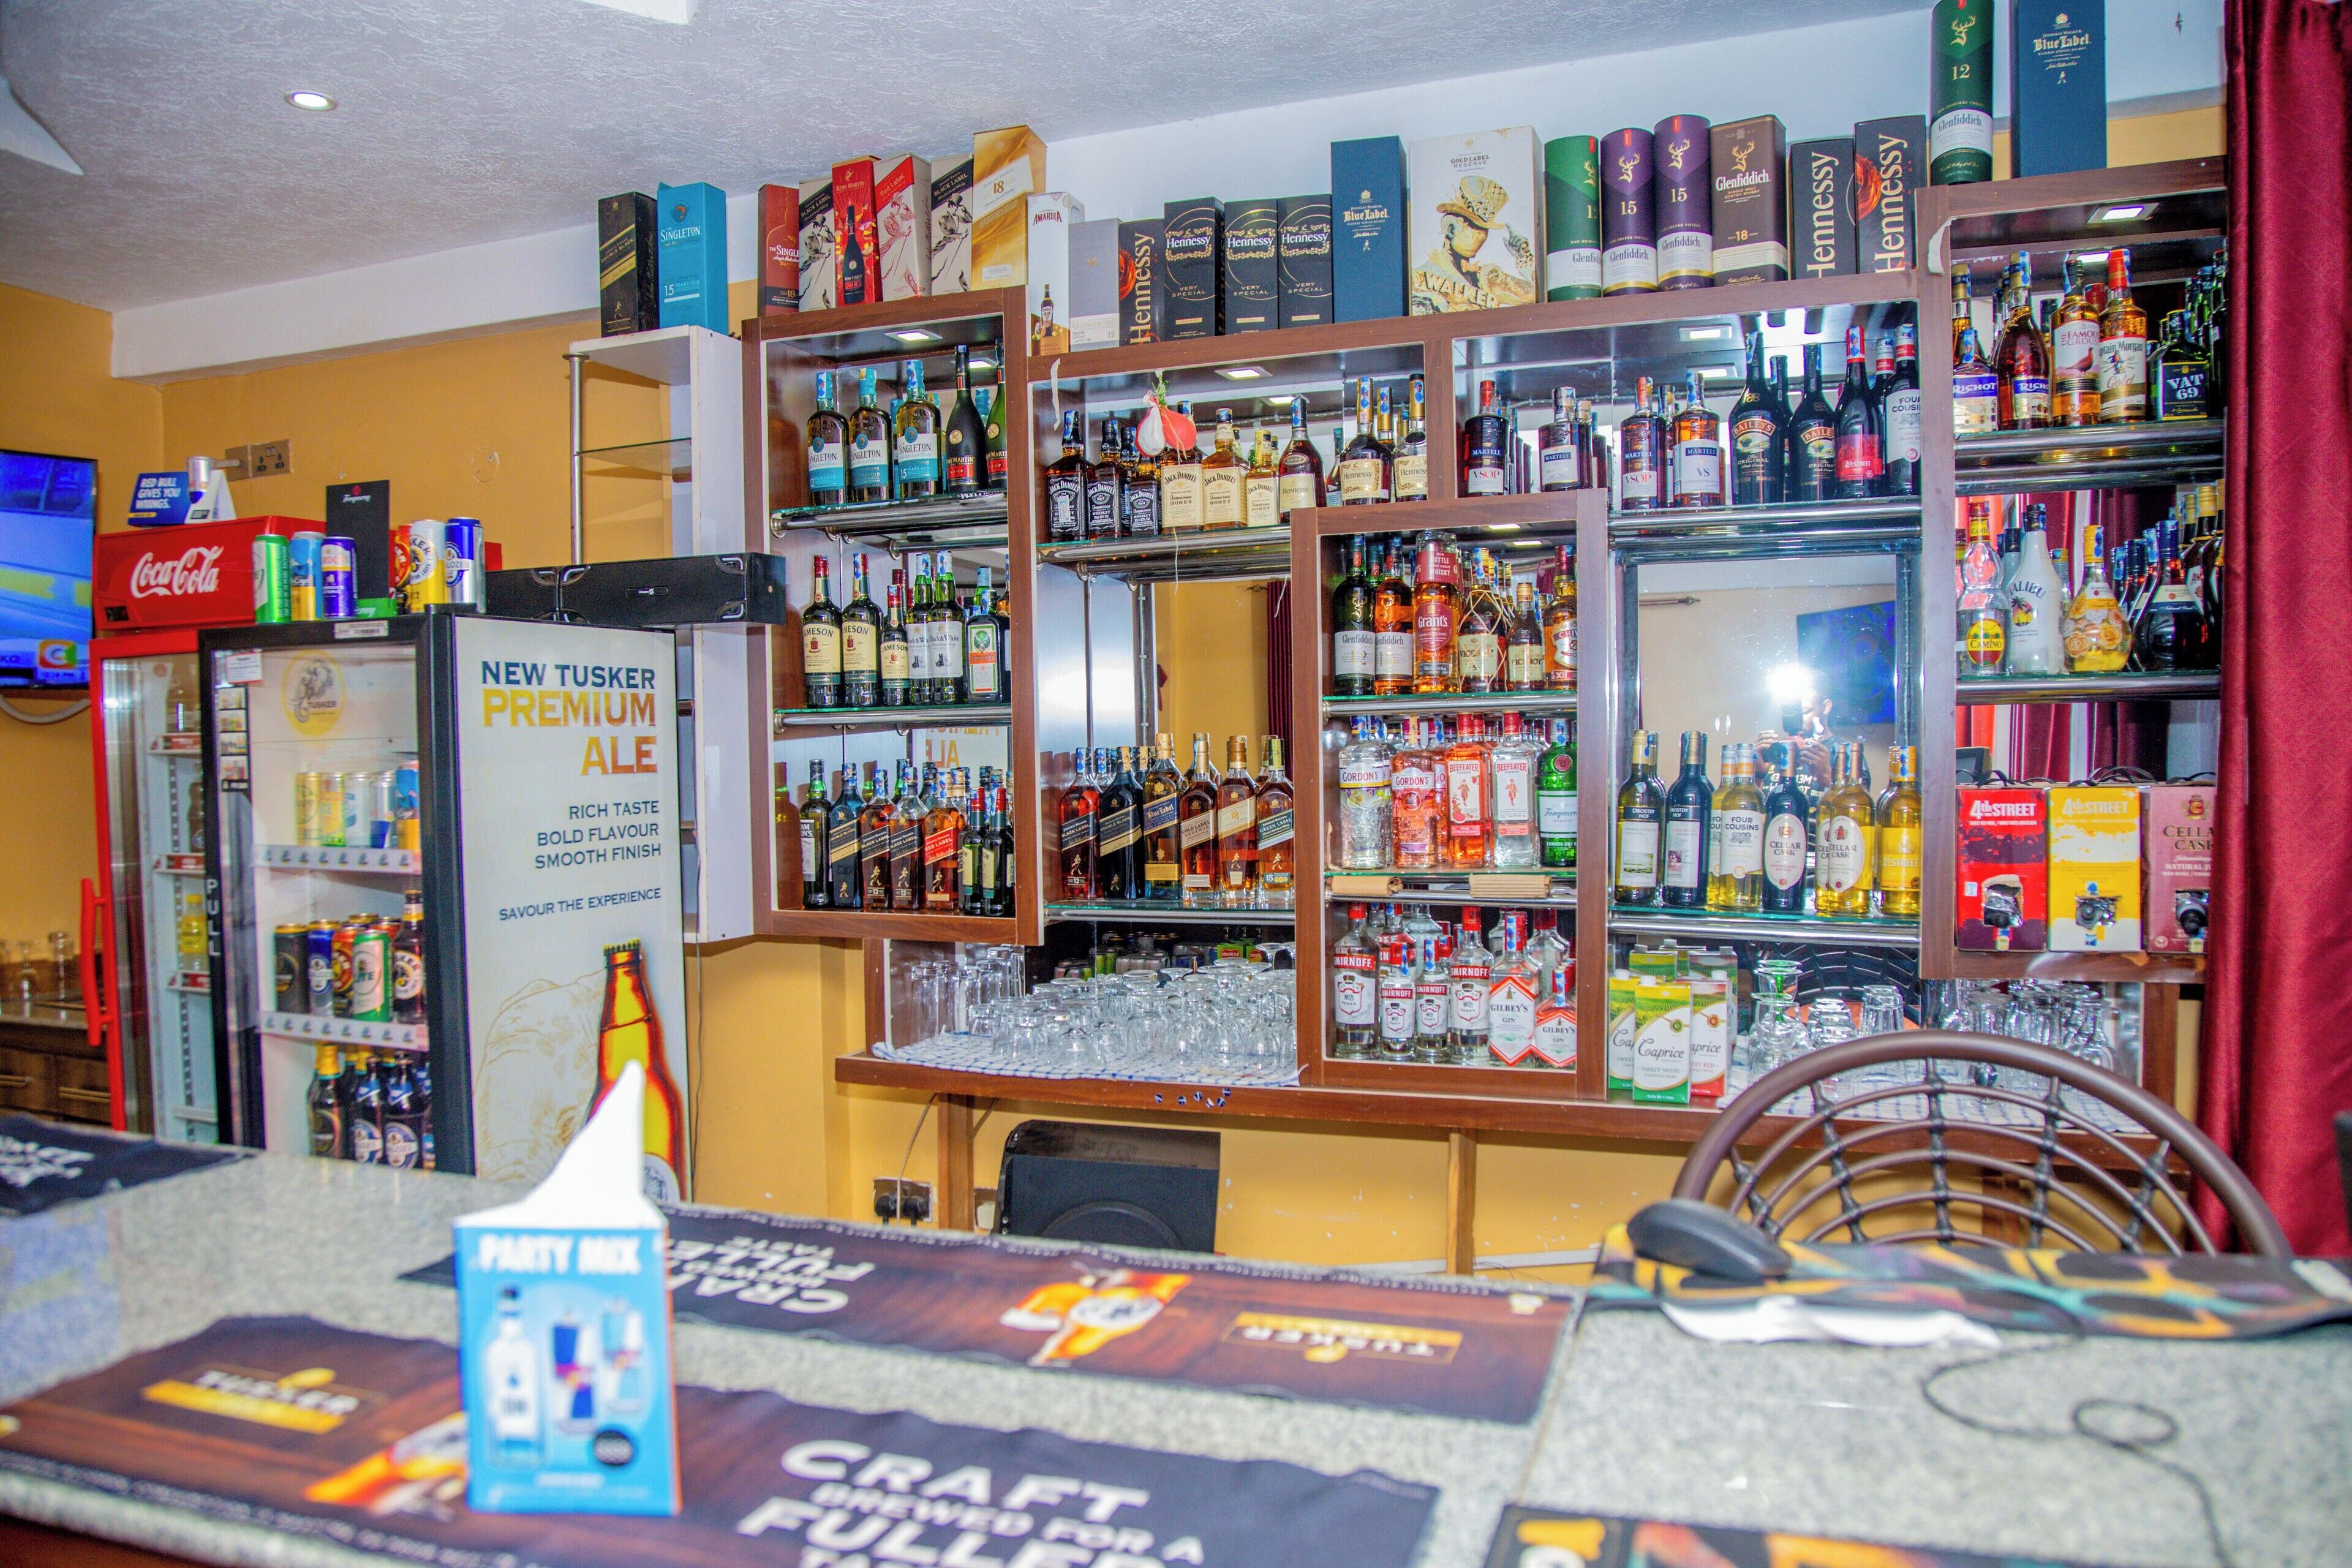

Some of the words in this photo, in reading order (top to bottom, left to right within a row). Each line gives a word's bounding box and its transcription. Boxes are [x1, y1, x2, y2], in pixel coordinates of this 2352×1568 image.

[2034, 39, 2059, 52] Blue
[2060, 34, 2091, 48] Label
[1953, 64, 1970, 80] 12
[1939, 114, 1982, 132] Glenfiddich
[880, 185, 891, 196] Red
[891, 173, 905, 187] Label
[934, 184, 951, 195] BLACK
[952, 173, 968, 184] LABEL
[1716, 169, 1770, 191] Glenfiddich
[993, 181, 1004, 194] 18
[1670, 187, 1687, 203] 15
[801, 204, 815, 217] BLACK
[816, 195, 831, 206] LABEL
[1621, 201, 1637, 215] 15
[1875, 134, 1907, 273] Hennessy
[1033, 211, 1062, 225] AMARULA
[1344, 210, 1364, 222] Blue
[1365, 208, 1388, 219] Label
[660, 226, 700, 242] SINGLETON
[1281, 232, 1328, 244] Hennessy
[1736, 230, 1747, 241] 18
[619, 238, 634, 251] BLACK
[1166, 235, 1211, 249] Hennessy
[1227, 237, 1273, 248] Hennessy
[1662, 235, 1700, 251] Glenfiddich
[1610, 249, 1648, 263] Glenfiddich
[664, 284, 674, 296] 15
[1130, 233, 1155, 344] Hennessy
[2119, 341, 2143, 352] Morgan
[2108, 375, 2135, 388] Gold
[2166, 374, 2204, 390] VAT
[2176, 387, 2199, 399] 69
[1733, 420, 1772, 435] BAILEYS
[140, 478, 156, 488] RED
[157, 477, 176, 487] BULL
[1165, 475, 1177, 485] JACK
[1177, 472, 1197, 482] DANIEL'S
[1204, 476, 1216, 486] JACK
[1216, 473, 1236, 484] DANIEL'S
[1343, 471, 1373, 480] Hennessy
[1473, 471, 1499, 480] VSOP
[1626, 474, 1652, 483] VSOP
[138, 488, 161, 499] GIVES
[1049, 484, 1060, 494] JACK
[1088, 487, 1098, 497] JACK
[1129, 493, 1138, 502] JACK
[1418, 616, 1447, 628] Grant's
[1342, 635, 1373, 644] Glenfiddich
[481, 660, 546, 687] NEW
[555, 664, 656, 689] TUSKER
[307, 700, 336, 709] TUSKER
[482, 688, 657, 727] PREMIUM
[581, 736, 658, 776] ALE
[1449, 763, 1479, 772] BEEFEATER
[1497, 763, 1528, 772] BEEFEATER
[1343, 771, 1379, 782] GORDON'S
[1395, 775, 1428, 786] GORDON'S
[569, 803, 608, 820] RICH
[613, 801, 660, 816] TASTE
[1100, 822, 1116, 832] DOUBLE
[1117, 816, 1131, 826] BLACK
[1181, 826, 1194, 834] GOLD
[1194, 820, 1211, 829] LABEL
[1260, 823, 1275, 833] GREEN
[1275, 817, 1291, 827] LABEL
[538, 829, 584, 846] BOLD
[589, 823, 659, 842] FLAVOUR
[935, 837, 952, 848] LABEL
[1770, 841, 1801, 850] CELLAR
[535, 850, 607, 869] SMOOTH
[613, 843, 661, 860] FINISH
[499, 902, 556, 921] SAVOUR
[558, 899, 583, 913] THE
[589, 888, 661, 909] EXPERIENCE
[206, 879, 221, 956] PULL
[1450, 966, 1488, 978] SMIRNOFF
[1381, 989, 1412, 998] SMIRNOFF
[1415, 985, 1447, 995] SMIRNOFF
[1490, 1004, 1528, 1012] GILBEY'S
[1638, 1038, 1684, 1061] Caprice
[478, 1235, 573, 1273] PARTY
[578, 1237, 641, 1274] MIX
[780, 1438, 1152, 1525] CRAFT
[809, 1481, 1036, 1537] BREWED
[1042, 1516, 1157, 1555] FOR
[1161, 1536, 1205, 1566] A
